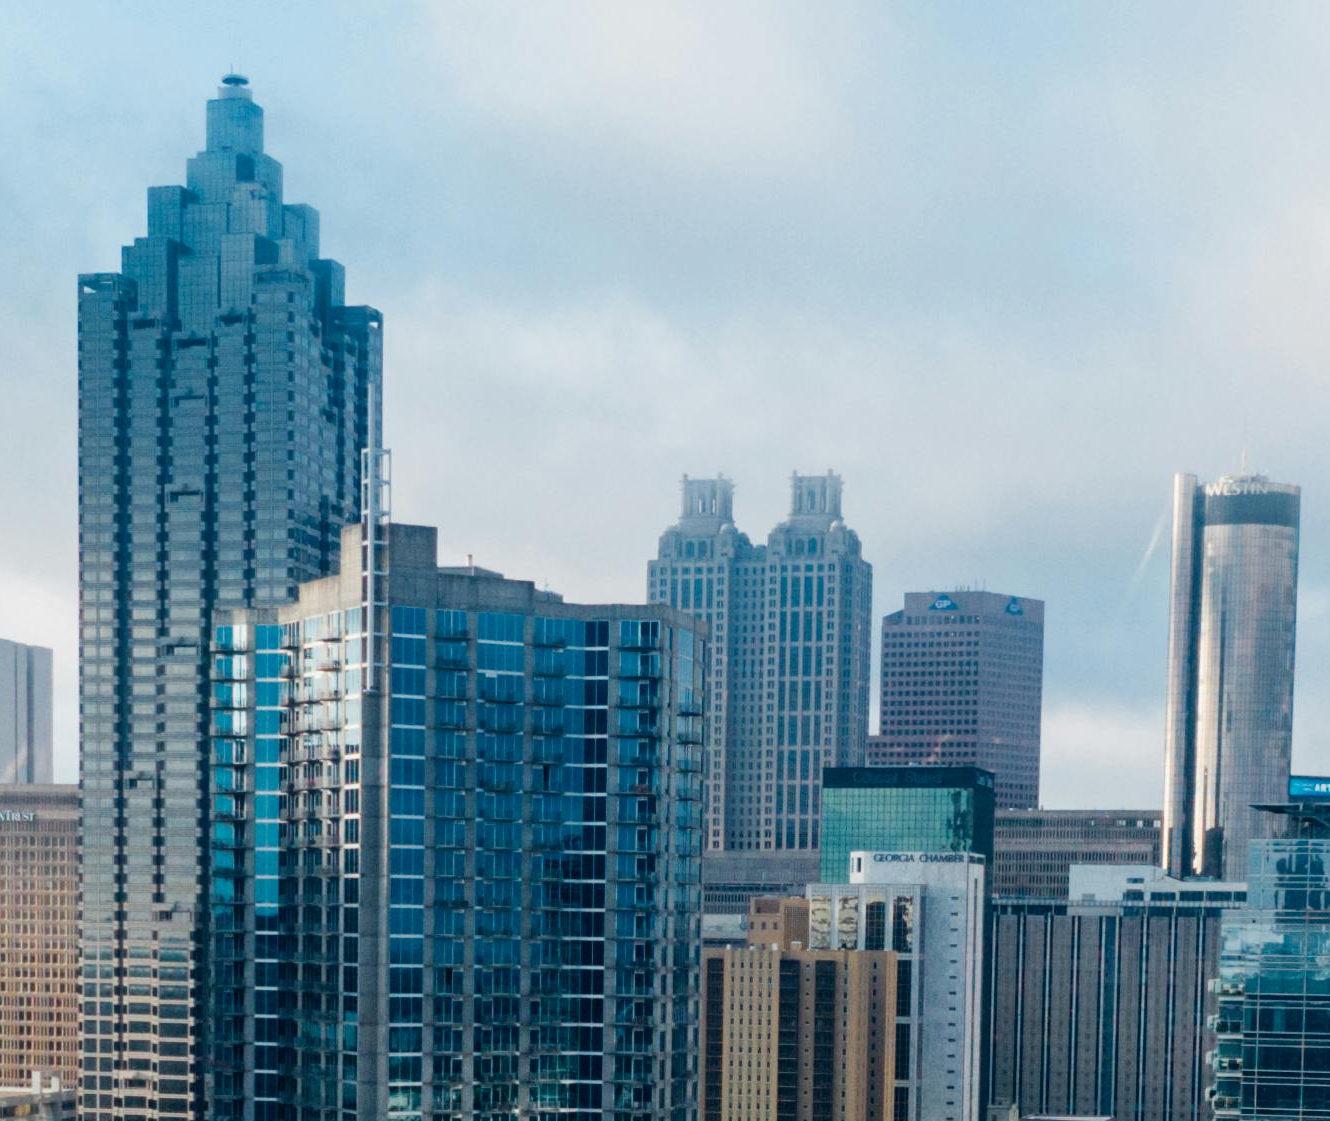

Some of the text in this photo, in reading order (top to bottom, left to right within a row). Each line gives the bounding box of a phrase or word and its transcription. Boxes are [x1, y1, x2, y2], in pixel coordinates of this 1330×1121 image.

[1205, 481, 1269, 496] WESTIN
[873, 854, 965, 863] GEORGIA CHAMBER
